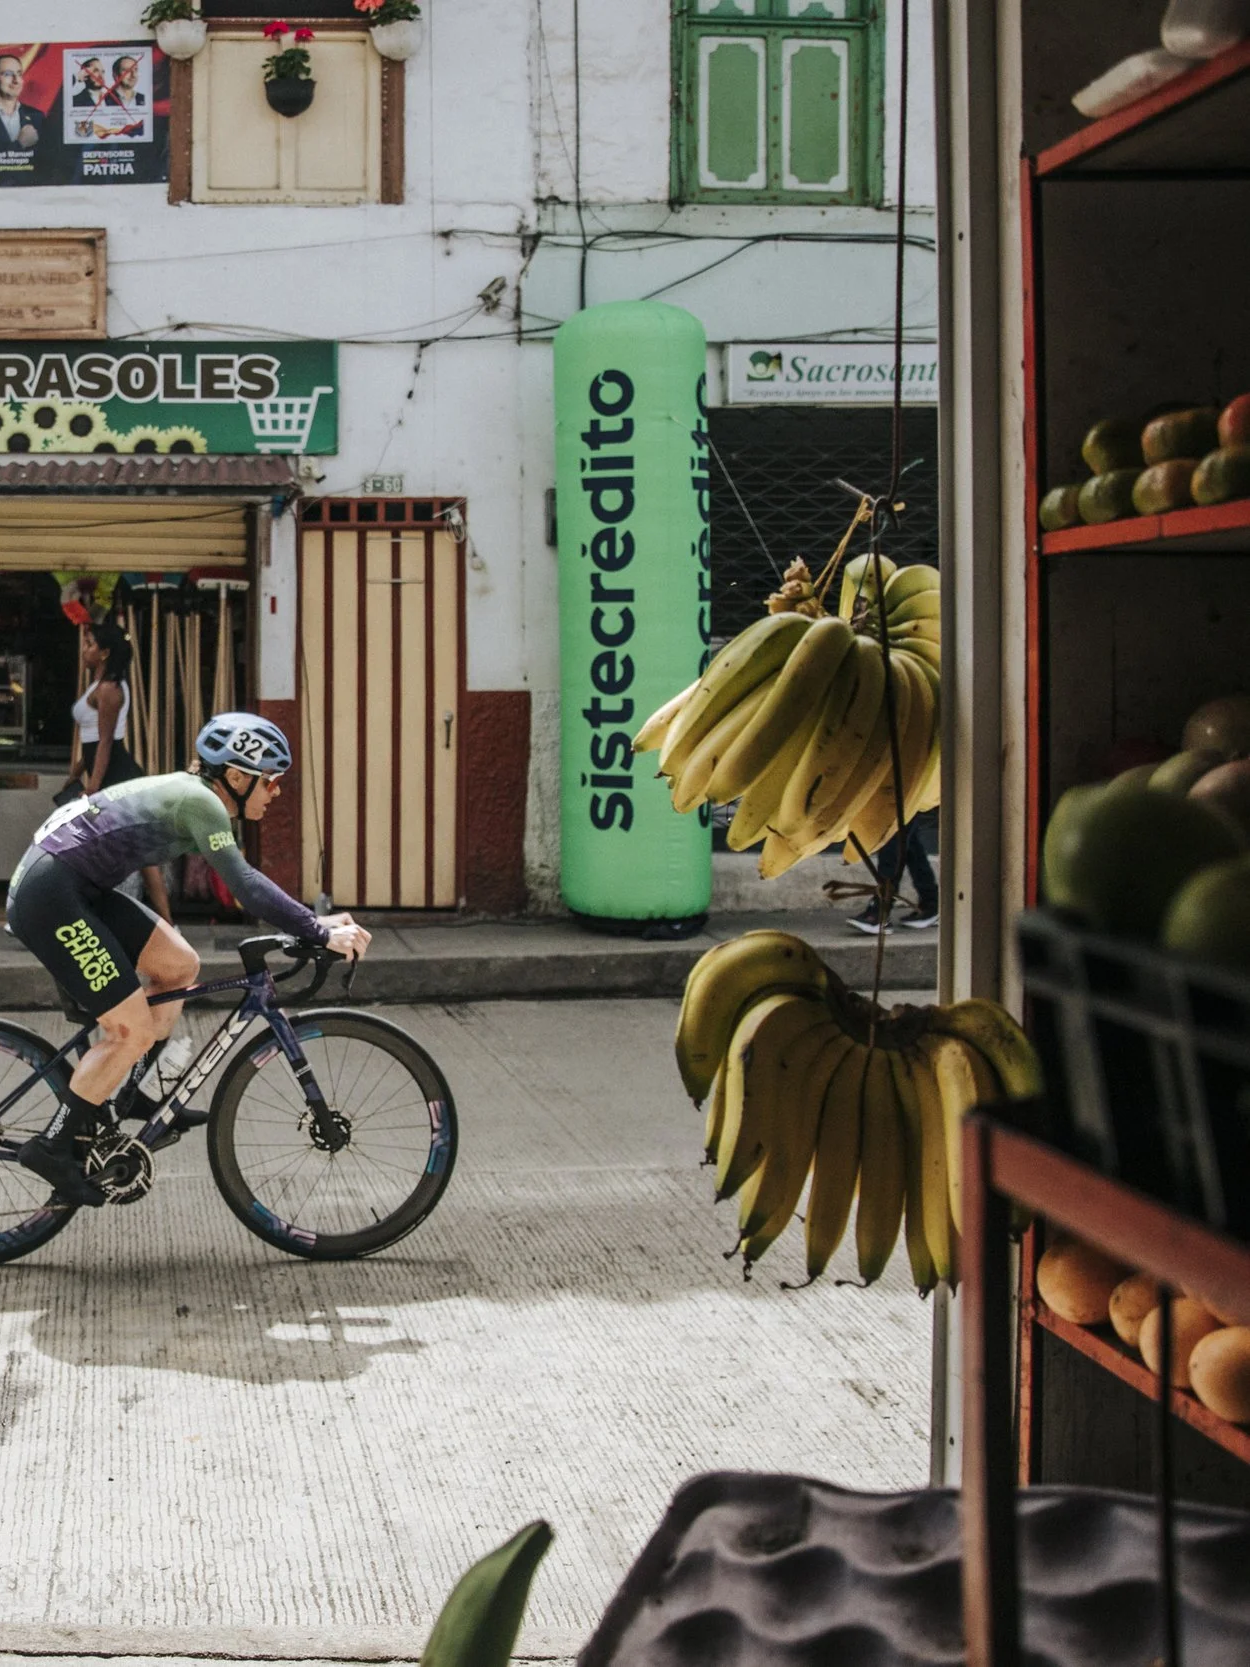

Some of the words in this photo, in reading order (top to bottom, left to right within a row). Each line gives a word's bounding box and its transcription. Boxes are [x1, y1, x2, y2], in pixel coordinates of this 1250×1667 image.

[83, 163, 135, 175] PATRIA
[232, 732, 263, 761] 32
[55, 925, 108, 992] CHAOS
[72, 919, 120, 980] PROJECT
[152, 1010, 248, 1125] TREK
